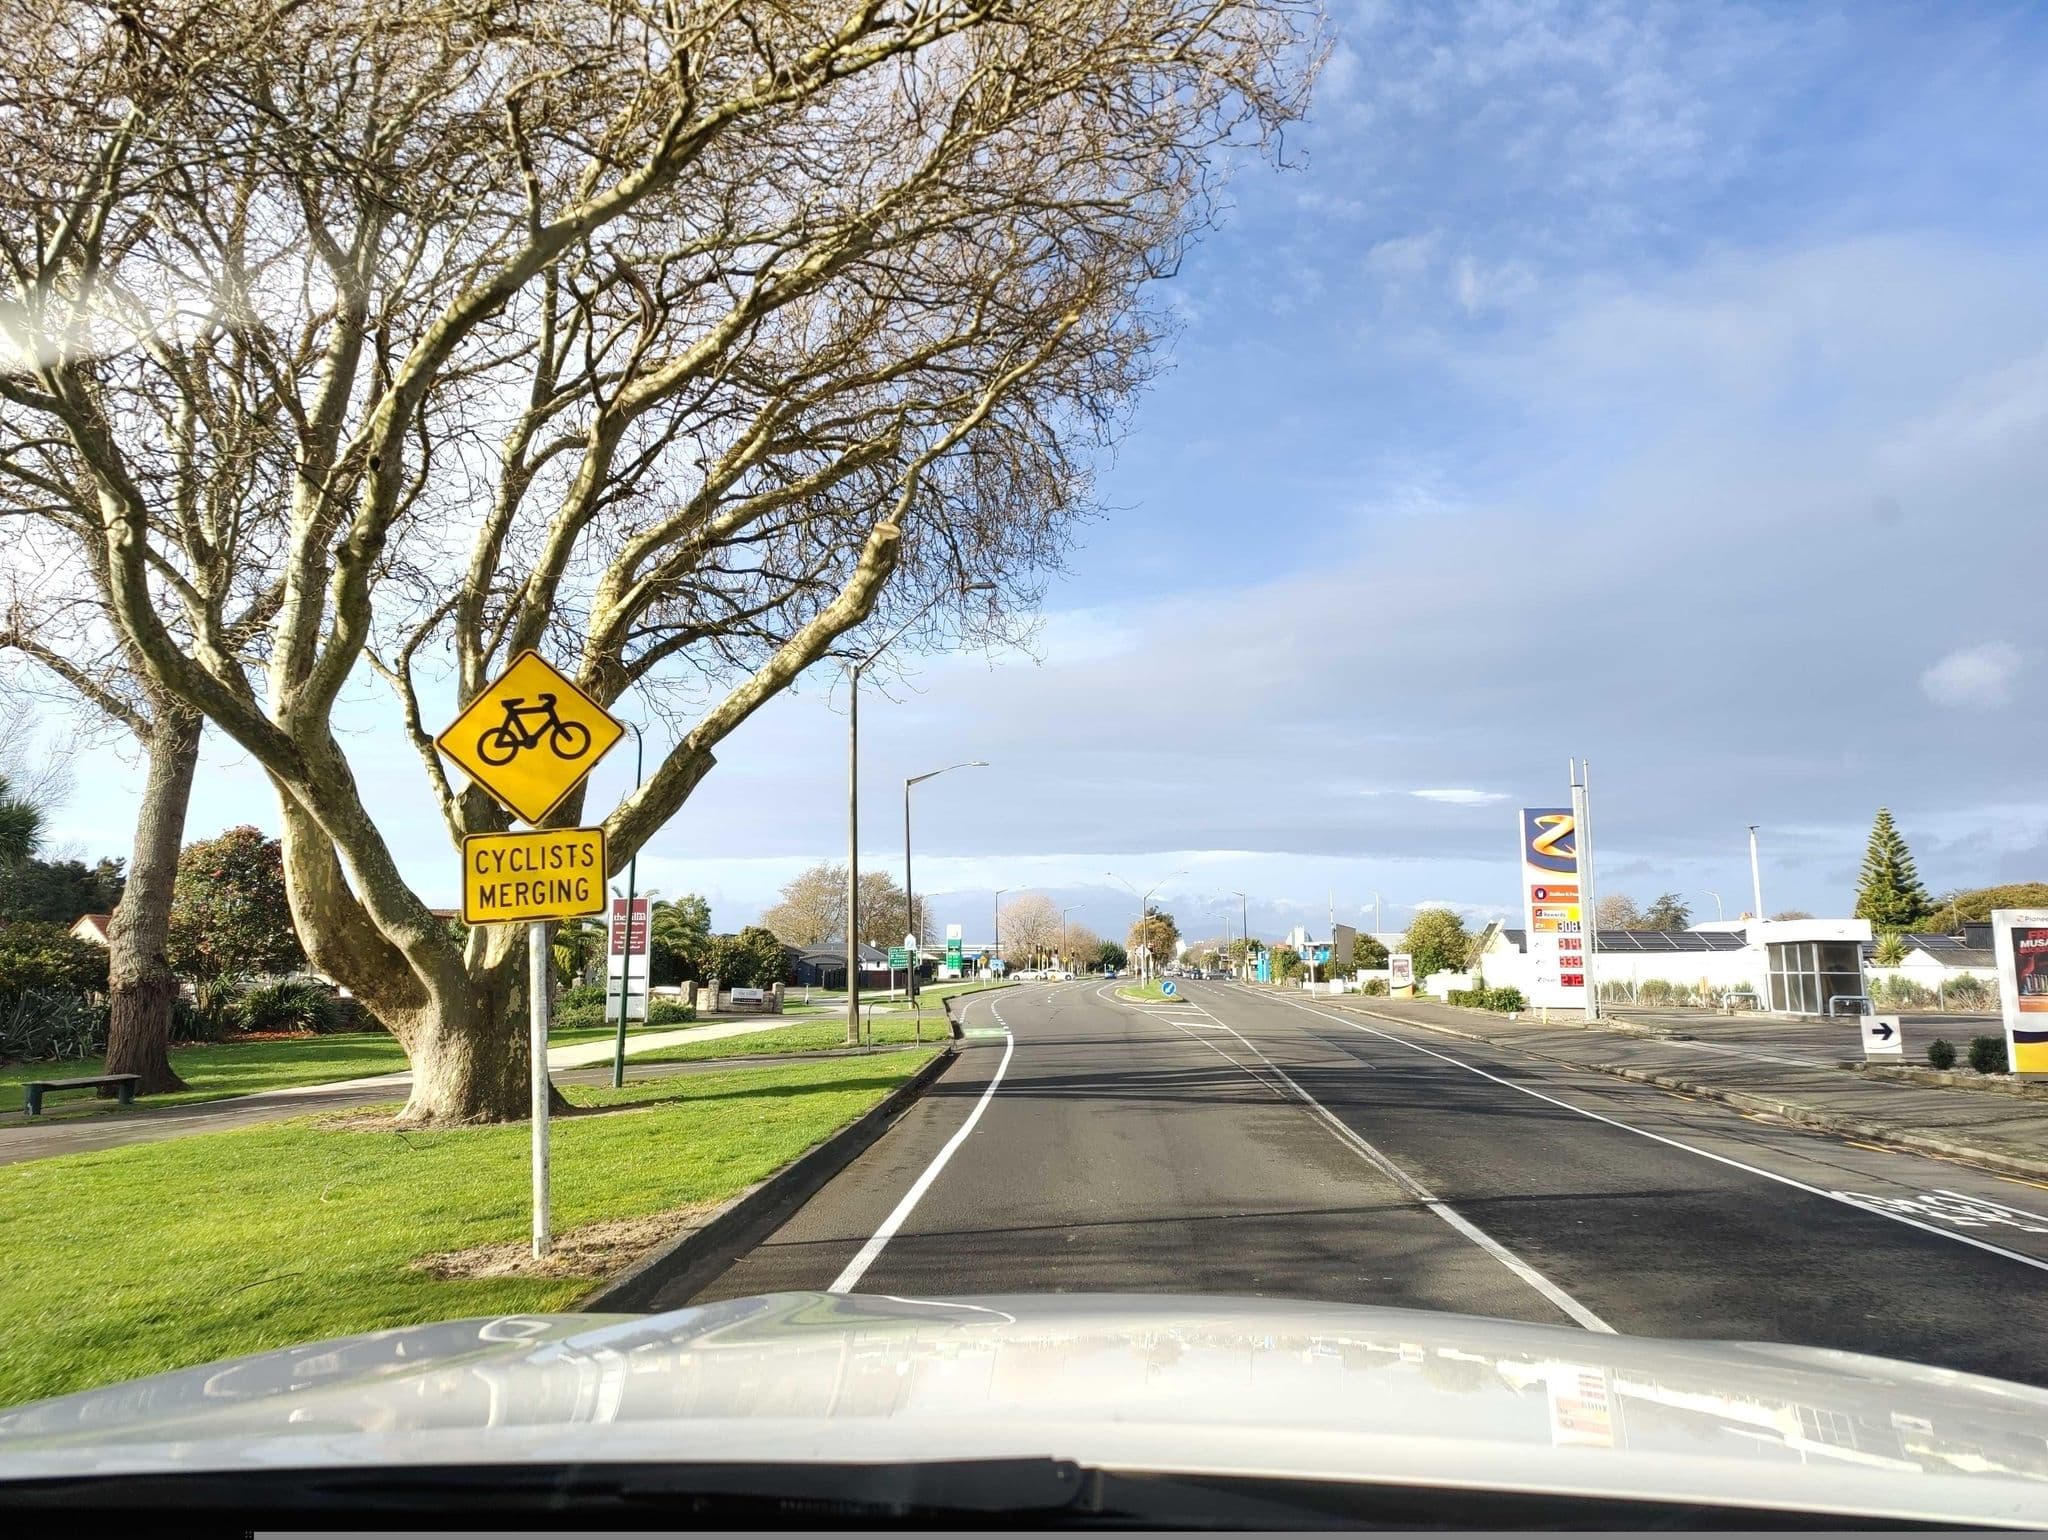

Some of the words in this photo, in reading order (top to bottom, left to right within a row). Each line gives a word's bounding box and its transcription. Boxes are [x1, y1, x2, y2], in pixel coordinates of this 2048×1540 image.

[476, 844, 593, 873] CYCLISTS
[480, 878, 588, 909] MERGING
[613, 912, 626, 921] the
[2028, 930, 2048, 939] FR
